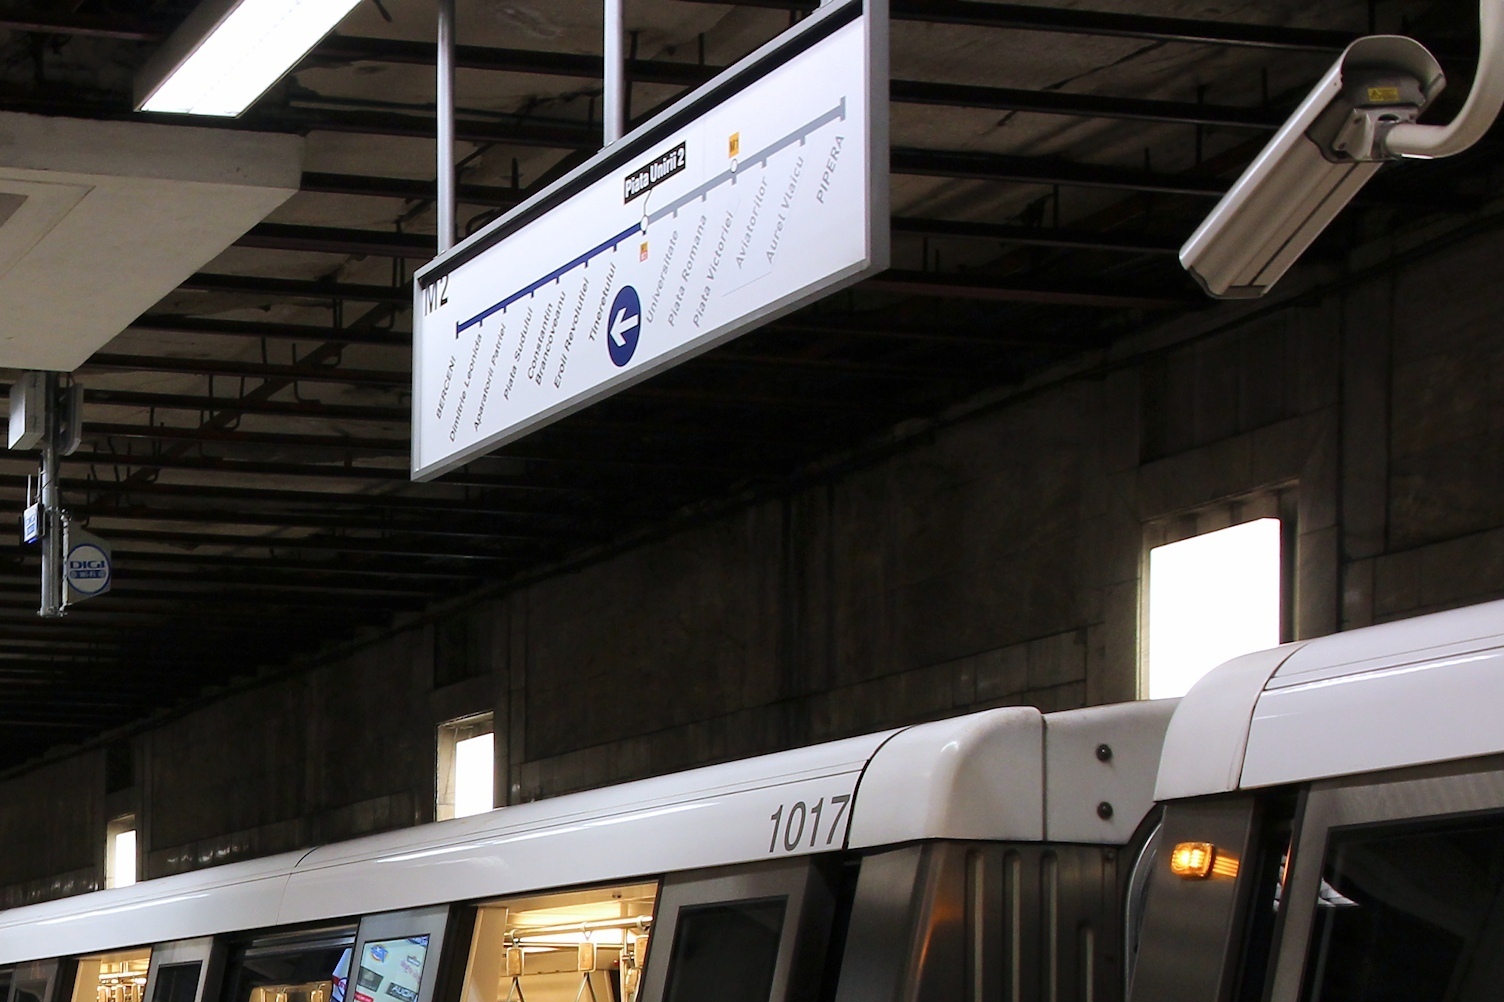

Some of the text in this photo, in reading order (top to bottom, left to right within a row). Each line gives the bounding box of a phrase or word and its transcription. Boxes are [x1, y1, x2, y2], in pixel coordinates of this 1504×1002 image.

[625, 147, 685, 198] Piata Unirii 2
[765, 157, 804, 264] Aurel Vlaicu
[816, 134, 845, 204] PIPERA
[692, 211, 734, 328] Piata Victoriei
[734, 177, 768, 269] Aviatorilor
[588, 262, 617, 342] Tineretului
[645, 230, 679, 325] Universitate
[667, 214, 707, 328] Piata Romana
[473, 323, 507, 432] Aparatorii Patriei
[503, 306, 534, 401] Piata Sudului
[527, 302, 554, 380] Constantin
[535, 291, 567, 387] Brancoveanu
[553, 276, 591, 390] Eroii Revolutiei
[436, 355, 457, 420] BERCENI
[449, 333, 483, 442] Dimitrie Leonida
[70, 561, 105, 569] DIGI
[769, 794, 851, 853] 1017
